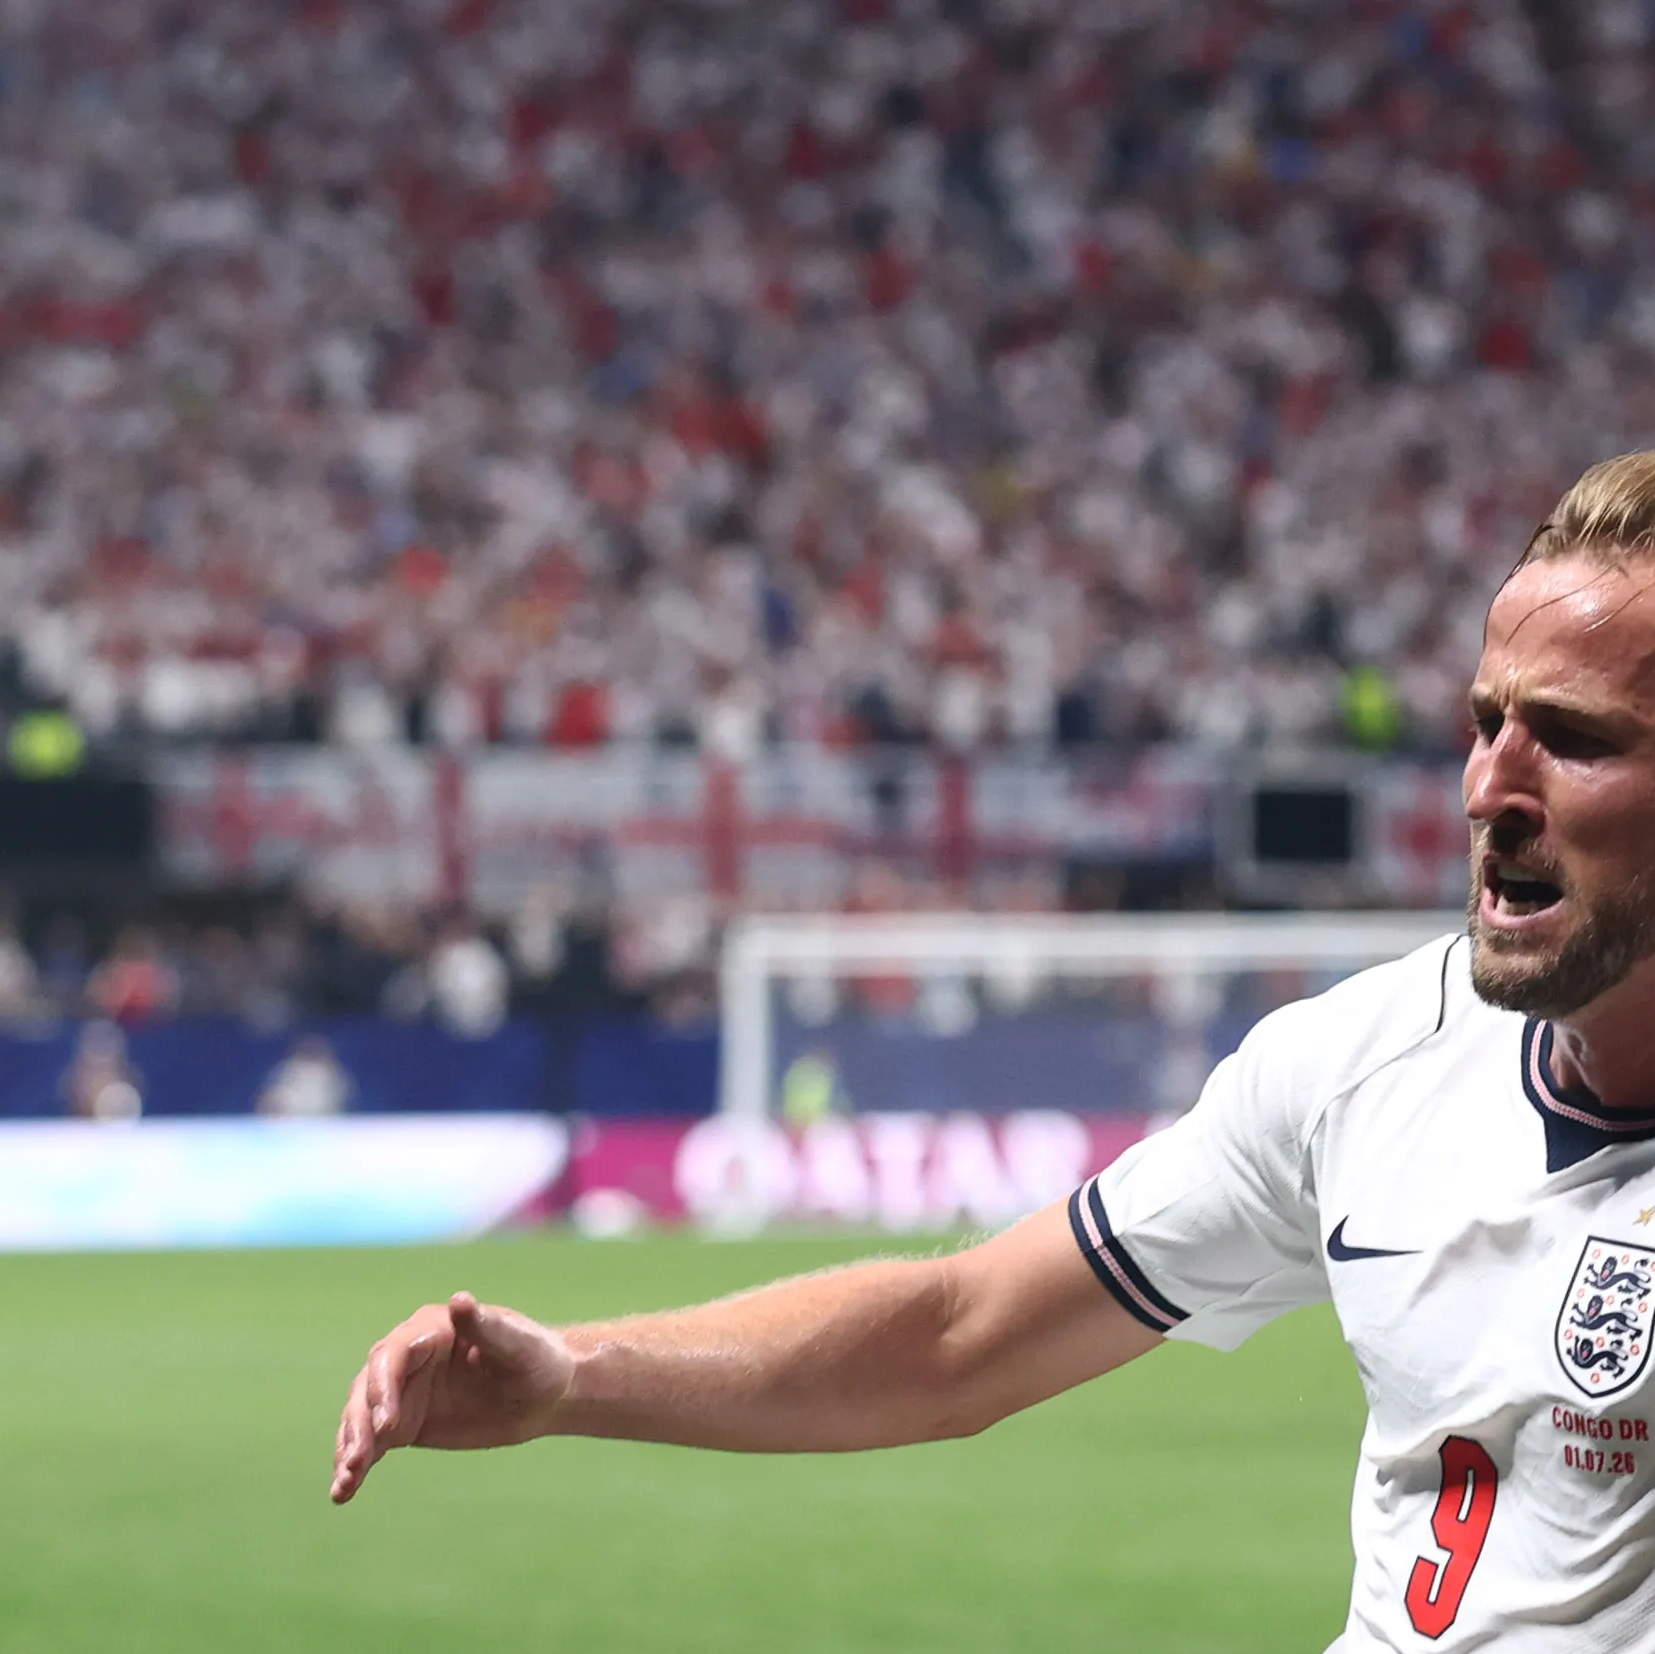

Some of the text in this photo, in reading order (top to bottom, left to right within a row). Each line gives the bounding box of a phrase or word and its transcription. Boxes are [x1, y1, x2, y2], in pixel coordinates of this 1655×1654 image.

[1552, 1405, 1649, 1441] CONGO DR
[1564, 1444, 1635, 1474] 01.07.26
[1404, 1434, 1498, 1640] 9
